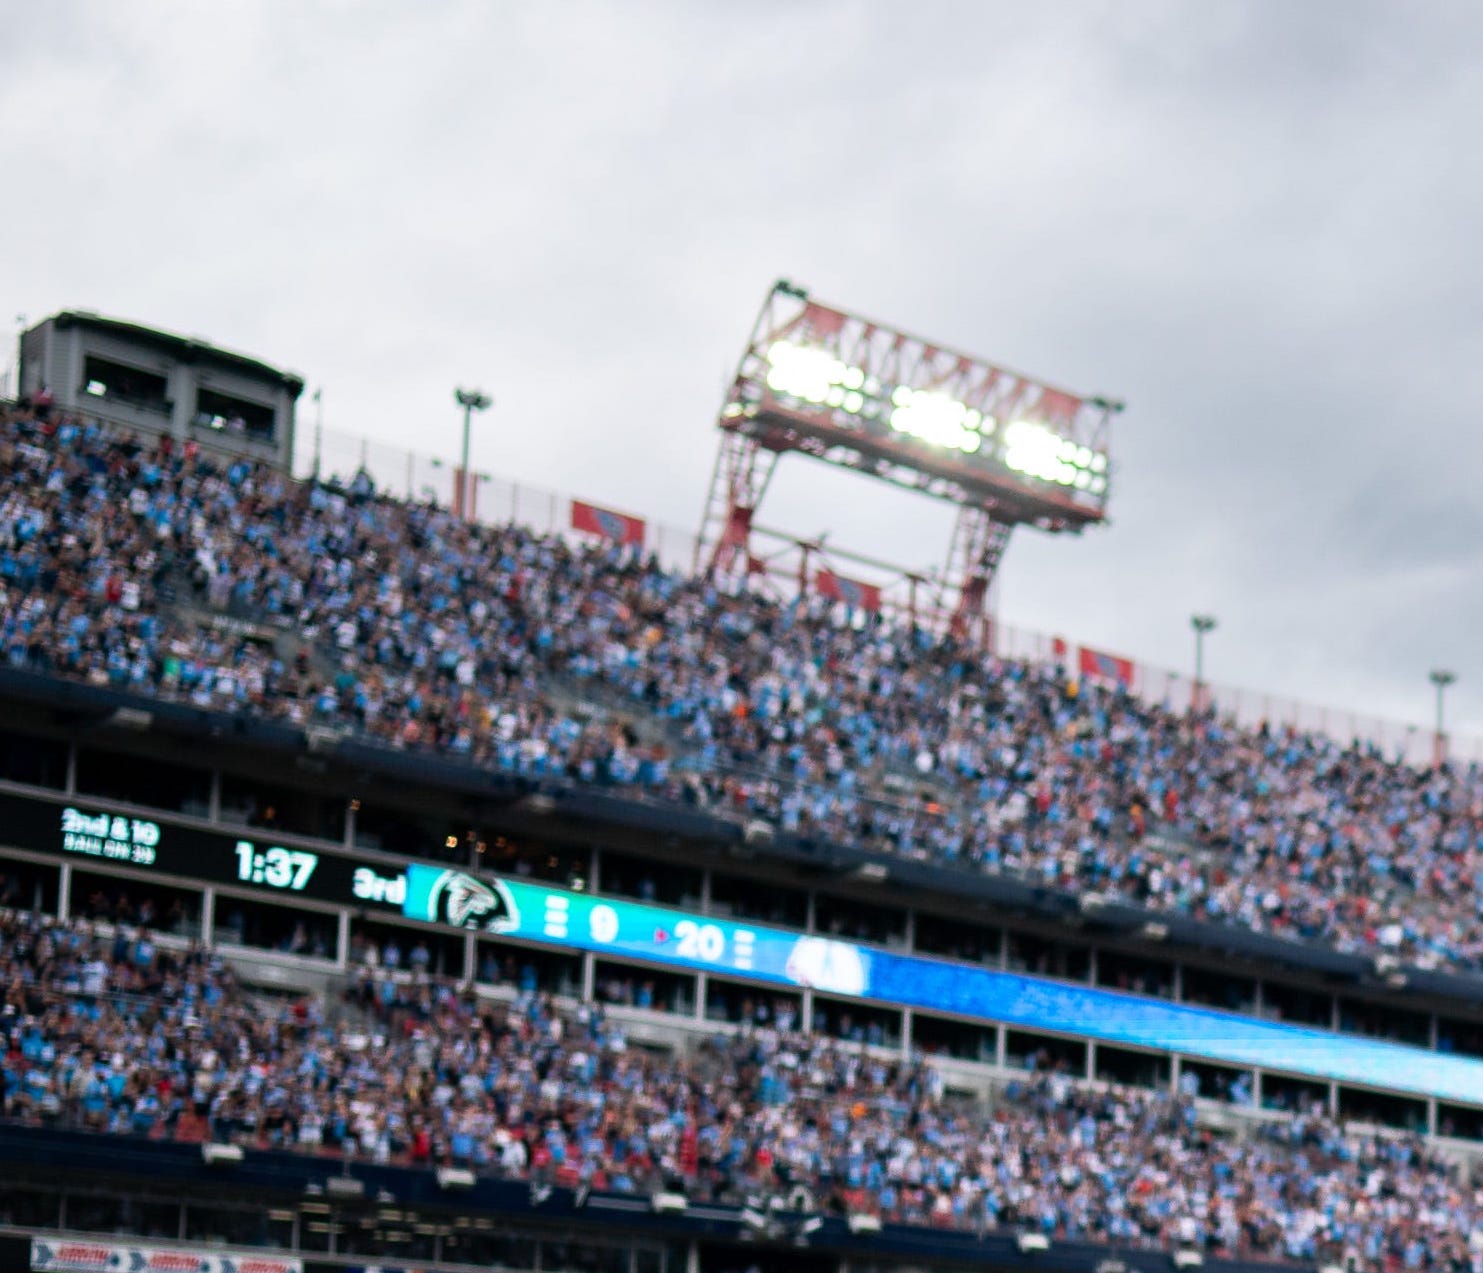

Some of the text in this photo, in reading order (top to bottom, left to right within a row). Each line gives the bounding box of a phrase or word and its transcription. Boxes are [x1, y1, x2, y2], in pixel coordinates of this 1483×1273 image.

[61, 808, 160, 846] 2nd & 10
[235, 841, 318, 890] 1:37
[353, 868, 406, 905] 3rd
[674, 920, 725, 961] 20
